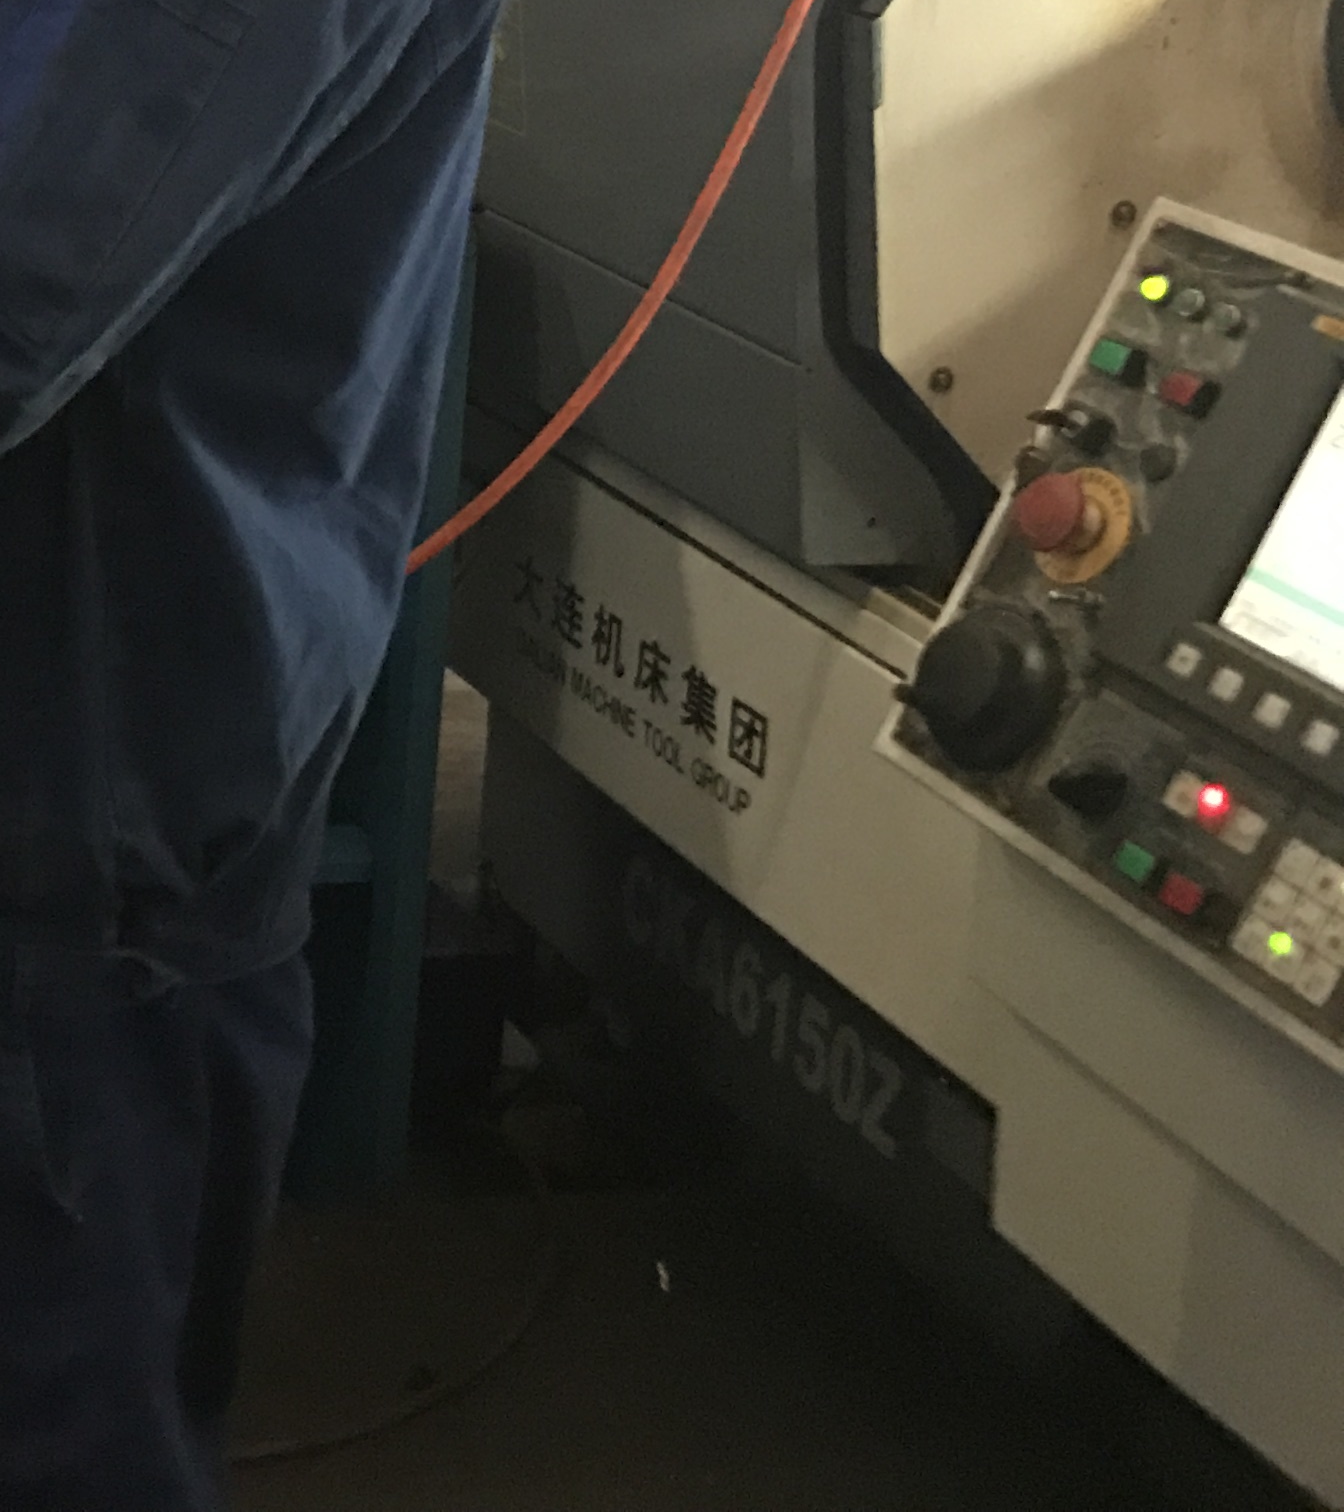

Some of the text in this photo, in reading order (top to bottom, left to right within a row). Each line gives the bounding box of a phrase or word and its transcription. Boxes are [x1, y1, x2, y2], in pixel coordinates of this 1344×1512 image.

[514, 557, 768, 778] 大连机床集团
[641, 719, 685, 774] TOOL
[691, 758, 752, 815] GROUP
